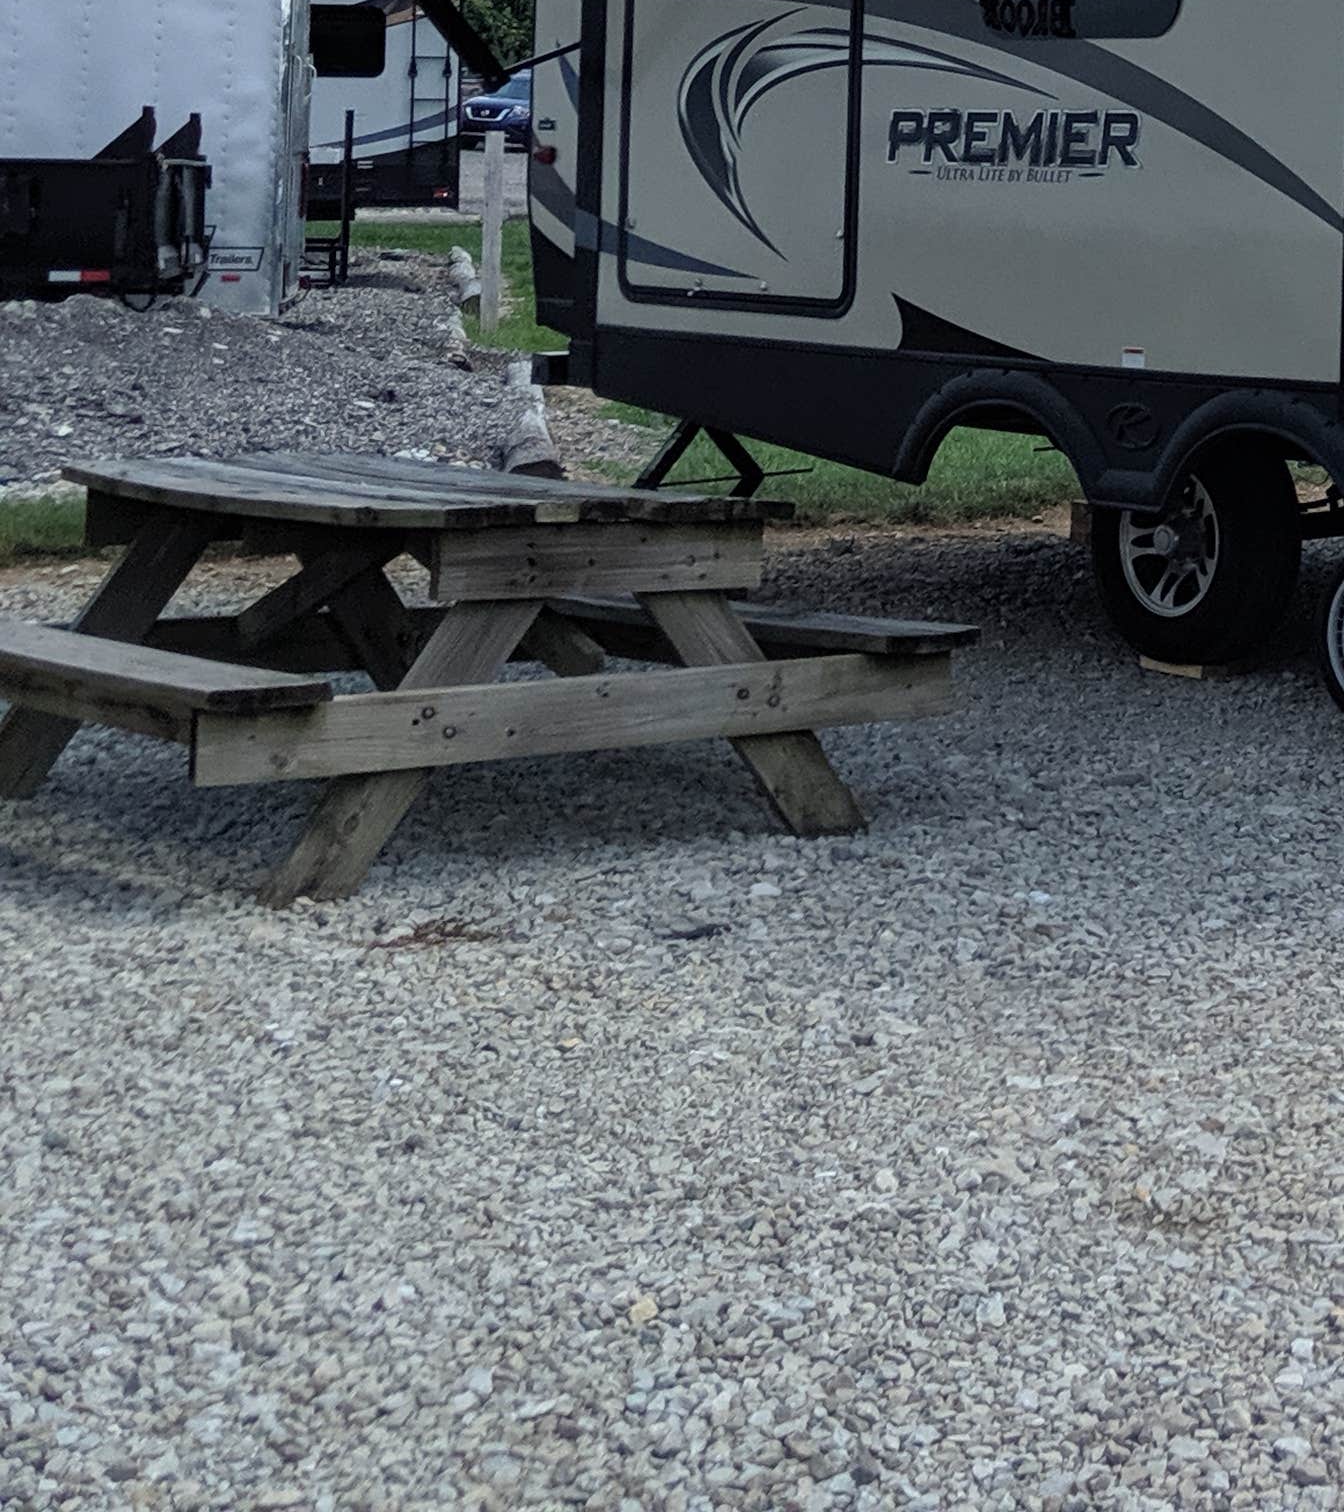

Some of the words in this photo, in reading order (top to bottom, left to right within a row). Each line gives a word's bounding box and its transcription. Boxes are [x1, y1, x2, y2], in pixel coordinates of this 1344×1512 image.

[887, 109, 1142, 168] PREMIER
[936, 166, 975, 181] ULTRA
[978, 166, 1005, 182] LITE
[1027, 168, 1072, 184] BULLET
